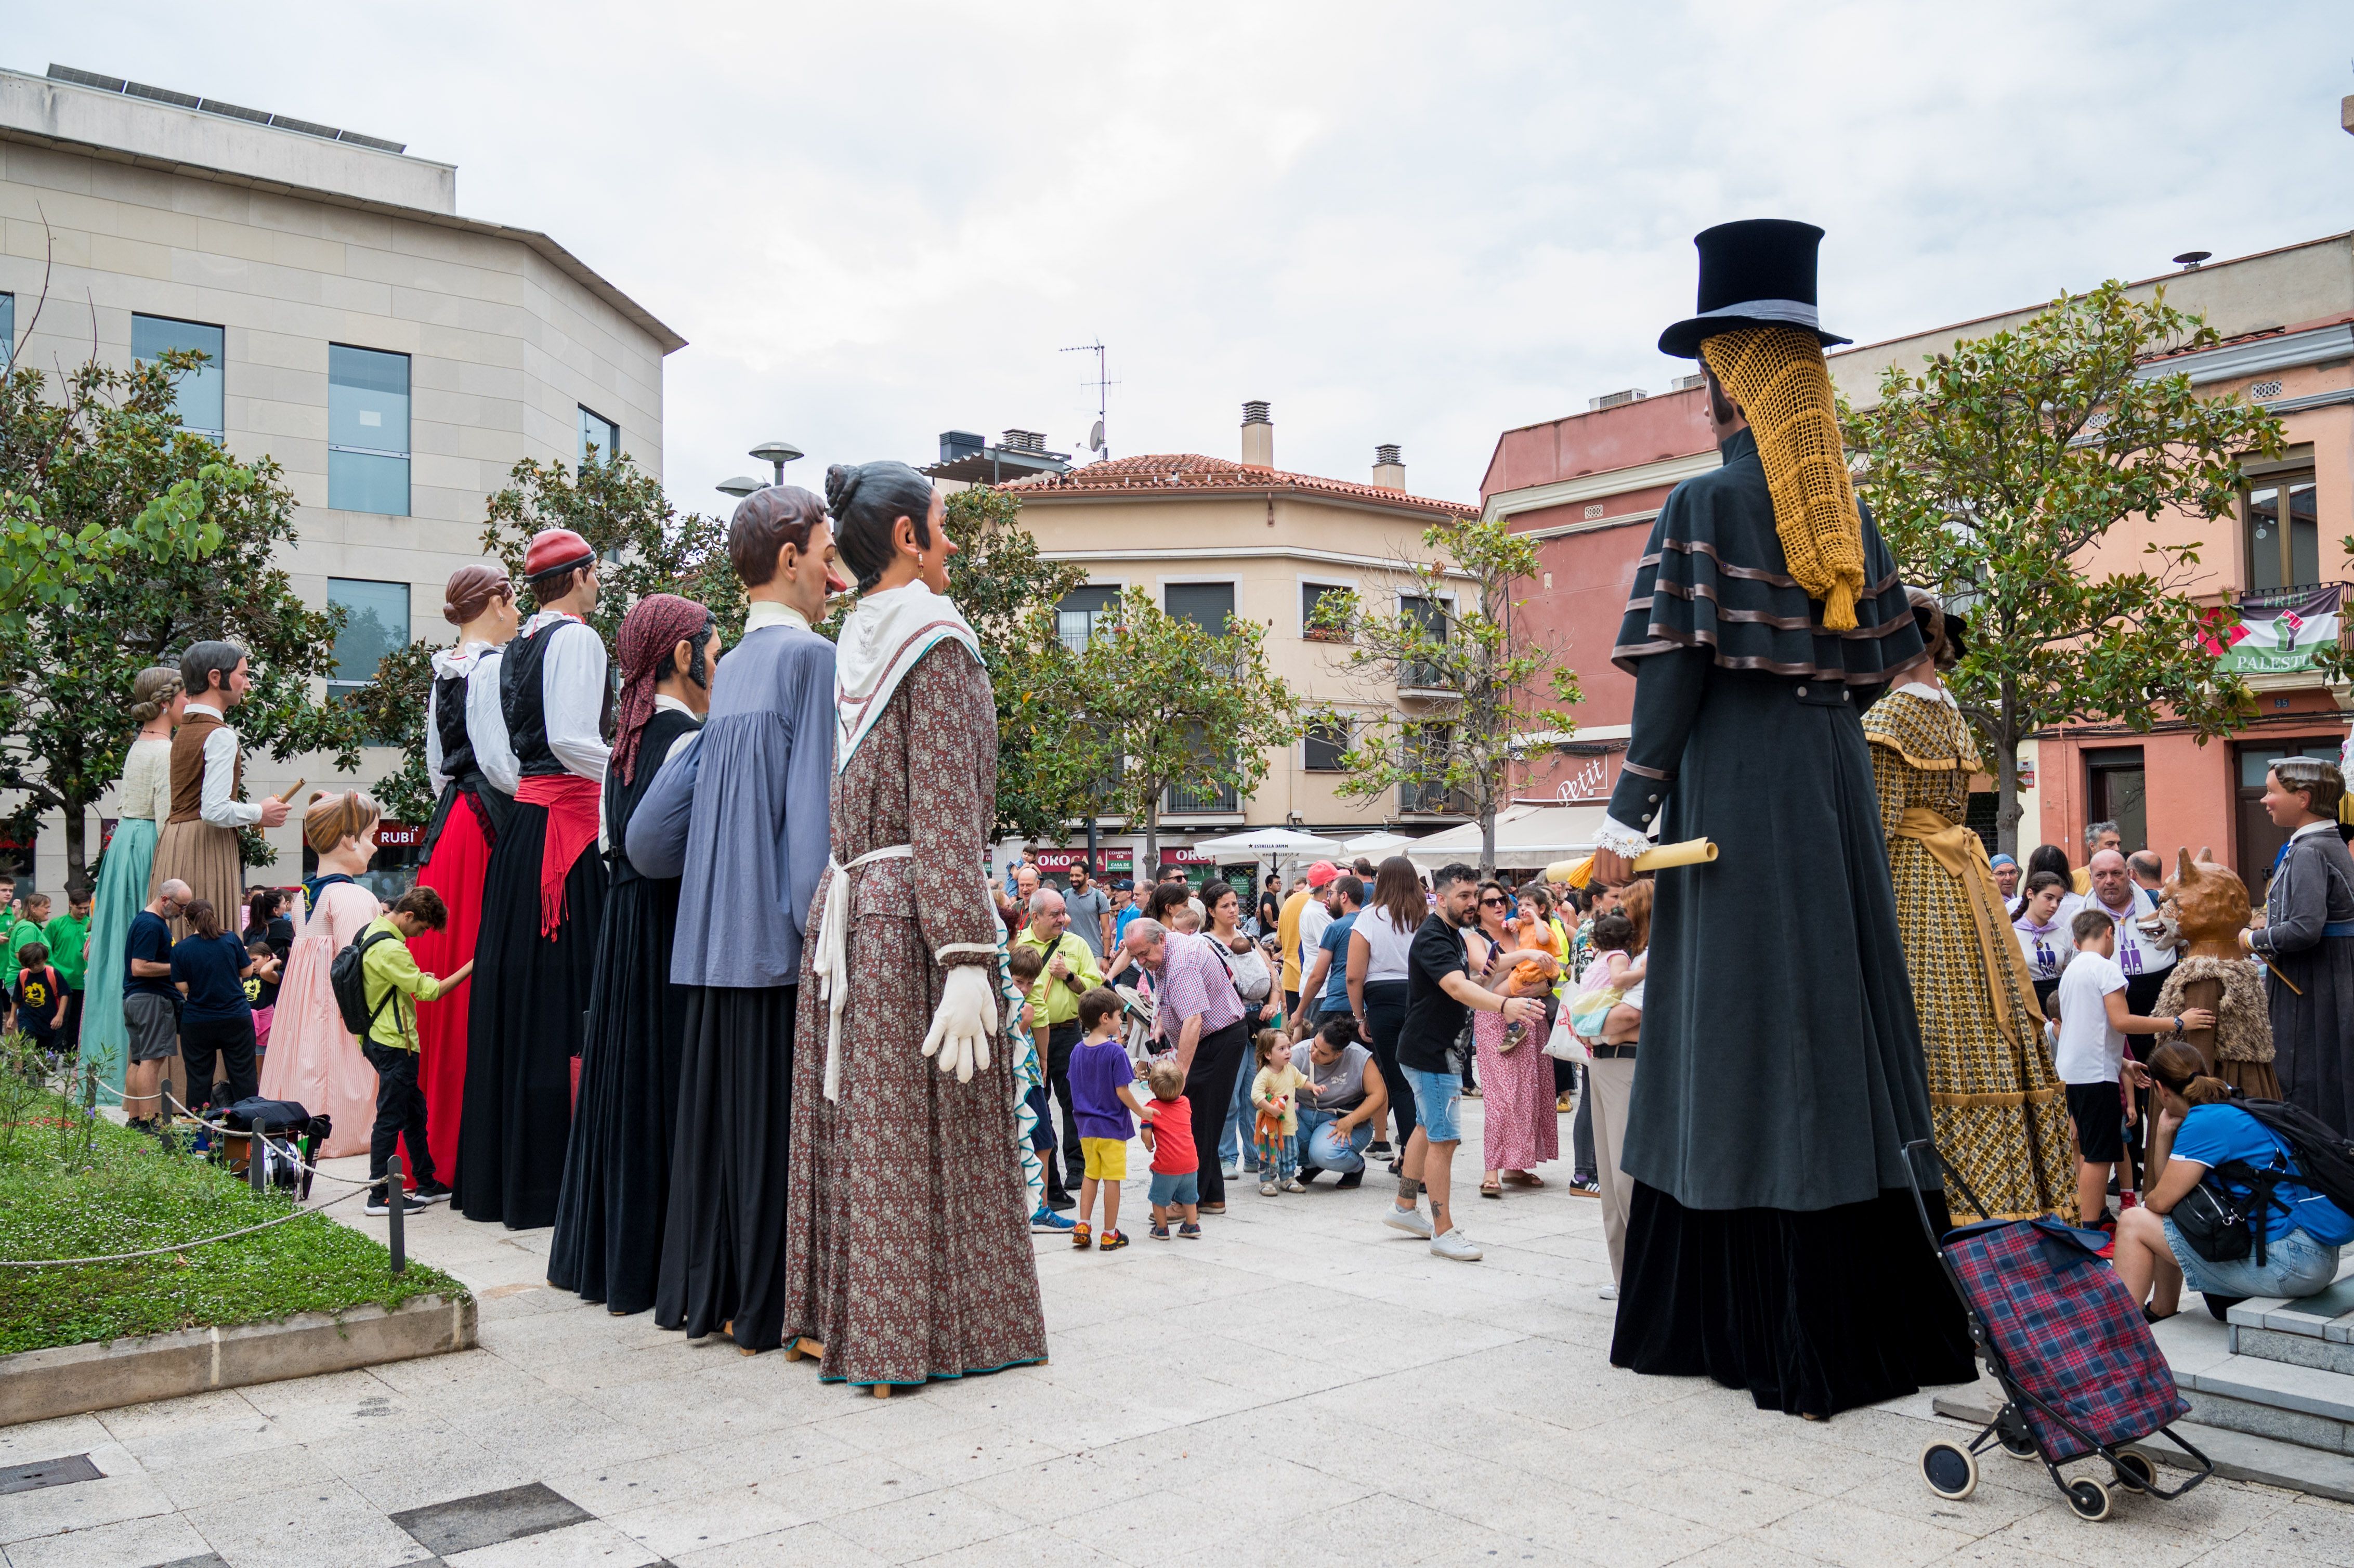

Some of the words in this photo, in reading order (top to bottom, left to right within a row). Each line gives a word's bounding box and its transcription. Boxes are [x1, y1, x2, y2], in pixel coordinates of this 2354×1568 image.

[2263, 593, 2309, 609] FREE
[2237, 651, 2330, 670] PALESTIN
[1557, 759, 1604, 807] Petit
[1038, 855, 1104, 866] OROCAA
